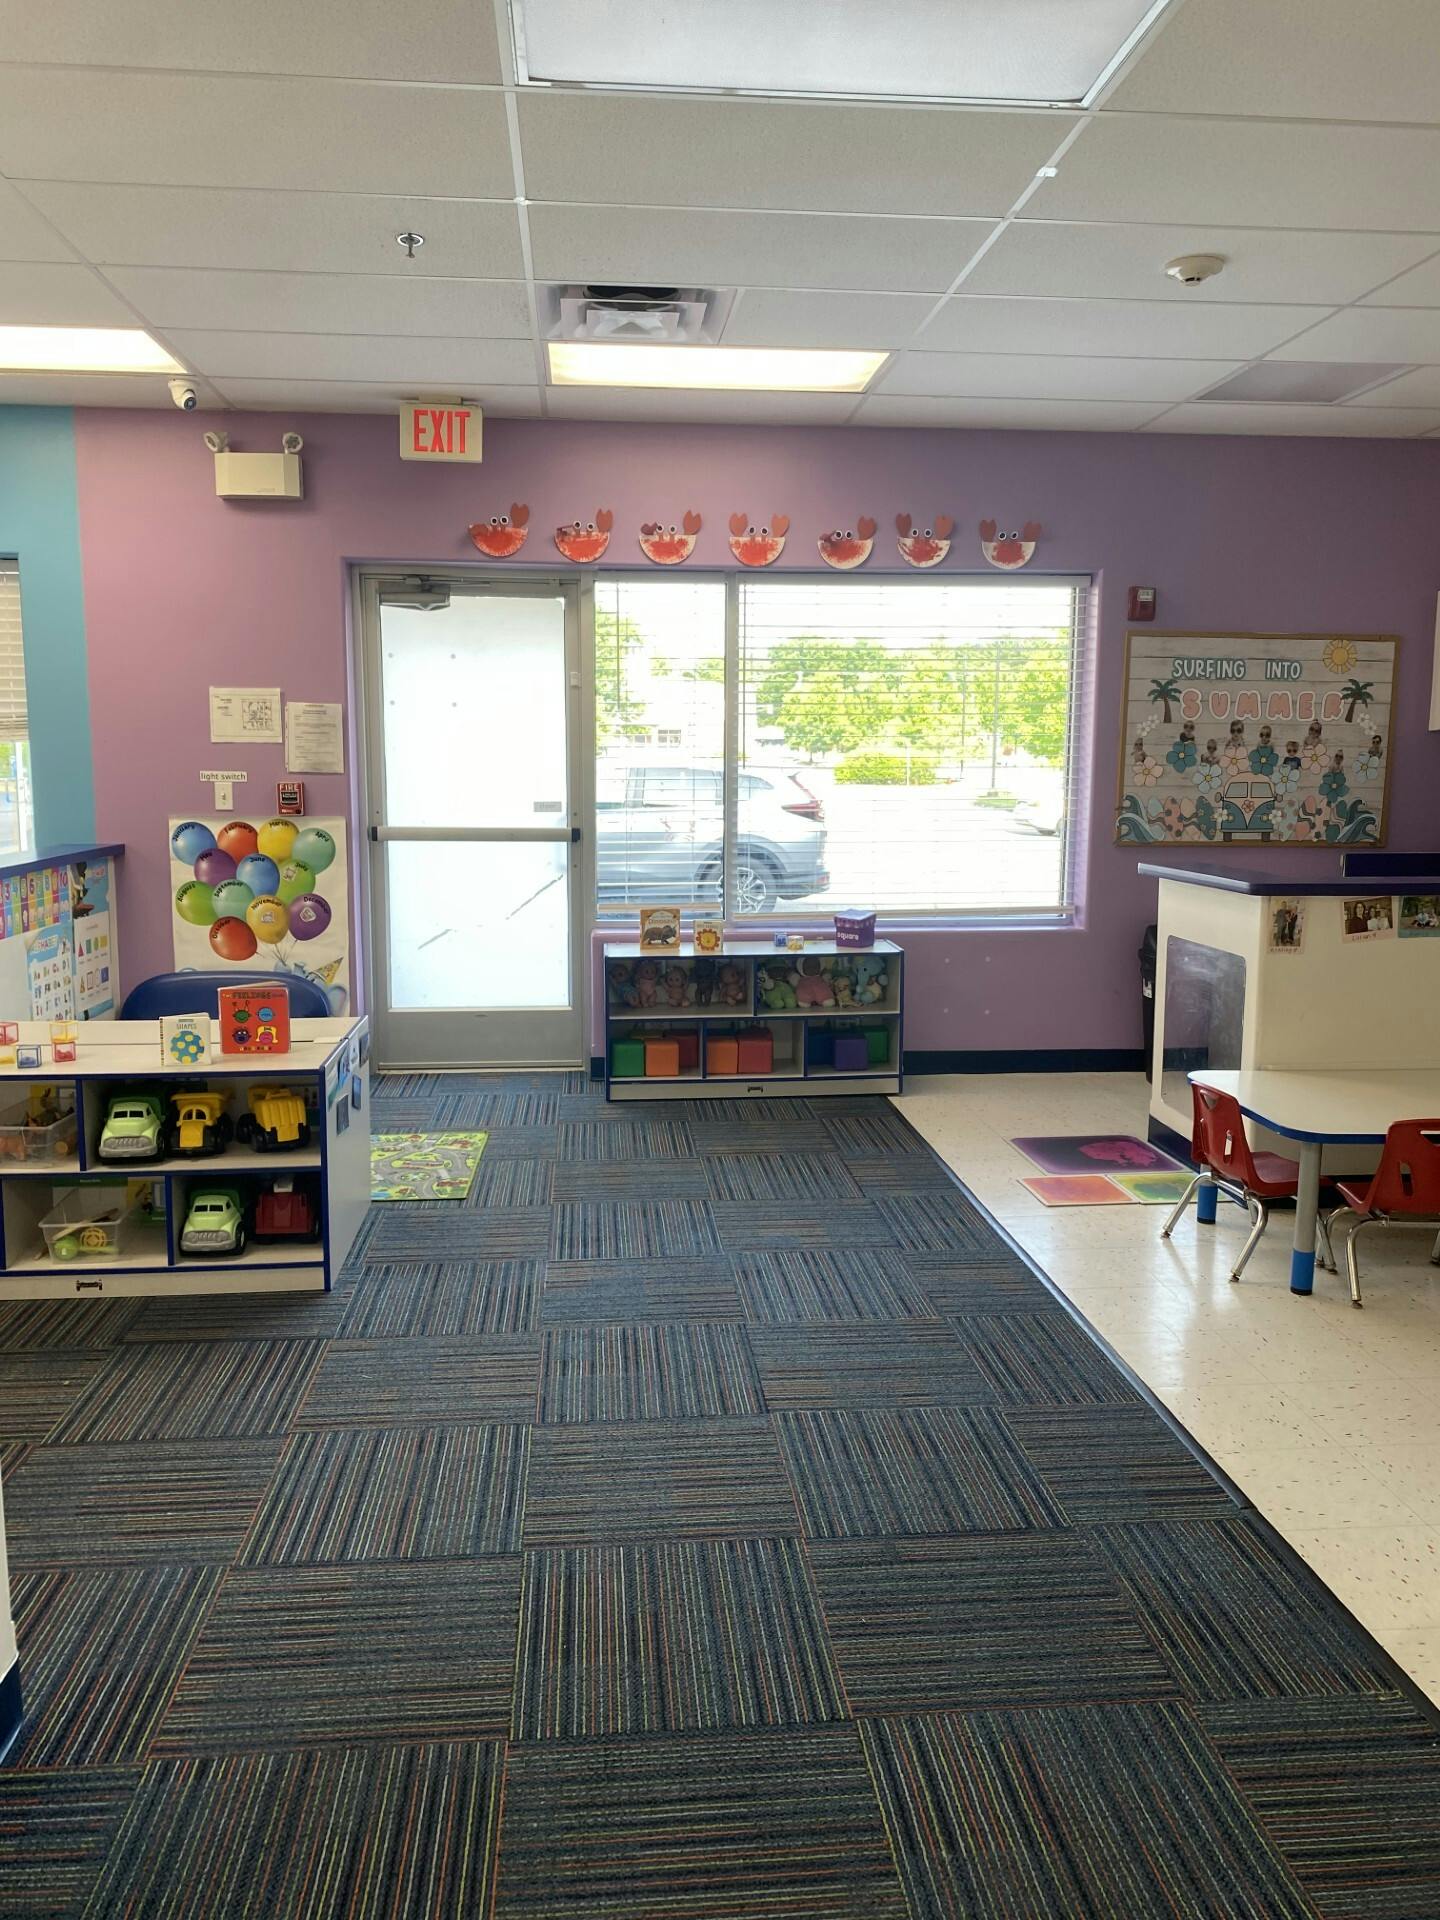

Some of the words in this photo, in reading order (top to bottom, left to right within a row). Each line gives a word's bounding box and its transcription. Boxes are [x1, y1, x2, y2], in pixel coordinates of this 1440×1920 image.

[414, 410, 470, 453] EXIT
[1172, 658, 1246, 679] SURFING
[1265, 660, 1302, 679] INTO
[1180, 688, 1345, 721] SUMMER
[200, 772, 219, 781] light
[220, 772, 246, 780] switch
[224, 825, 254, 834] February
[269, 820, 290, 828] March
[172, 824, 195, 842] January
[314, 831, 330, 843] April
[294, 862, 309, 872] July
[29, 878, 35, 895] 6
[60, 871, 69, 887] 10
[213, 881, 243, 898] September
[177, 883, 196, 902] August
[250, 898, 283, 910] November
[303, 896, 329, 914] December
[211, 918, 231, 939] October
[837, 932, 859, 941] square
[232, 991, 271, 999] FEELINGS
